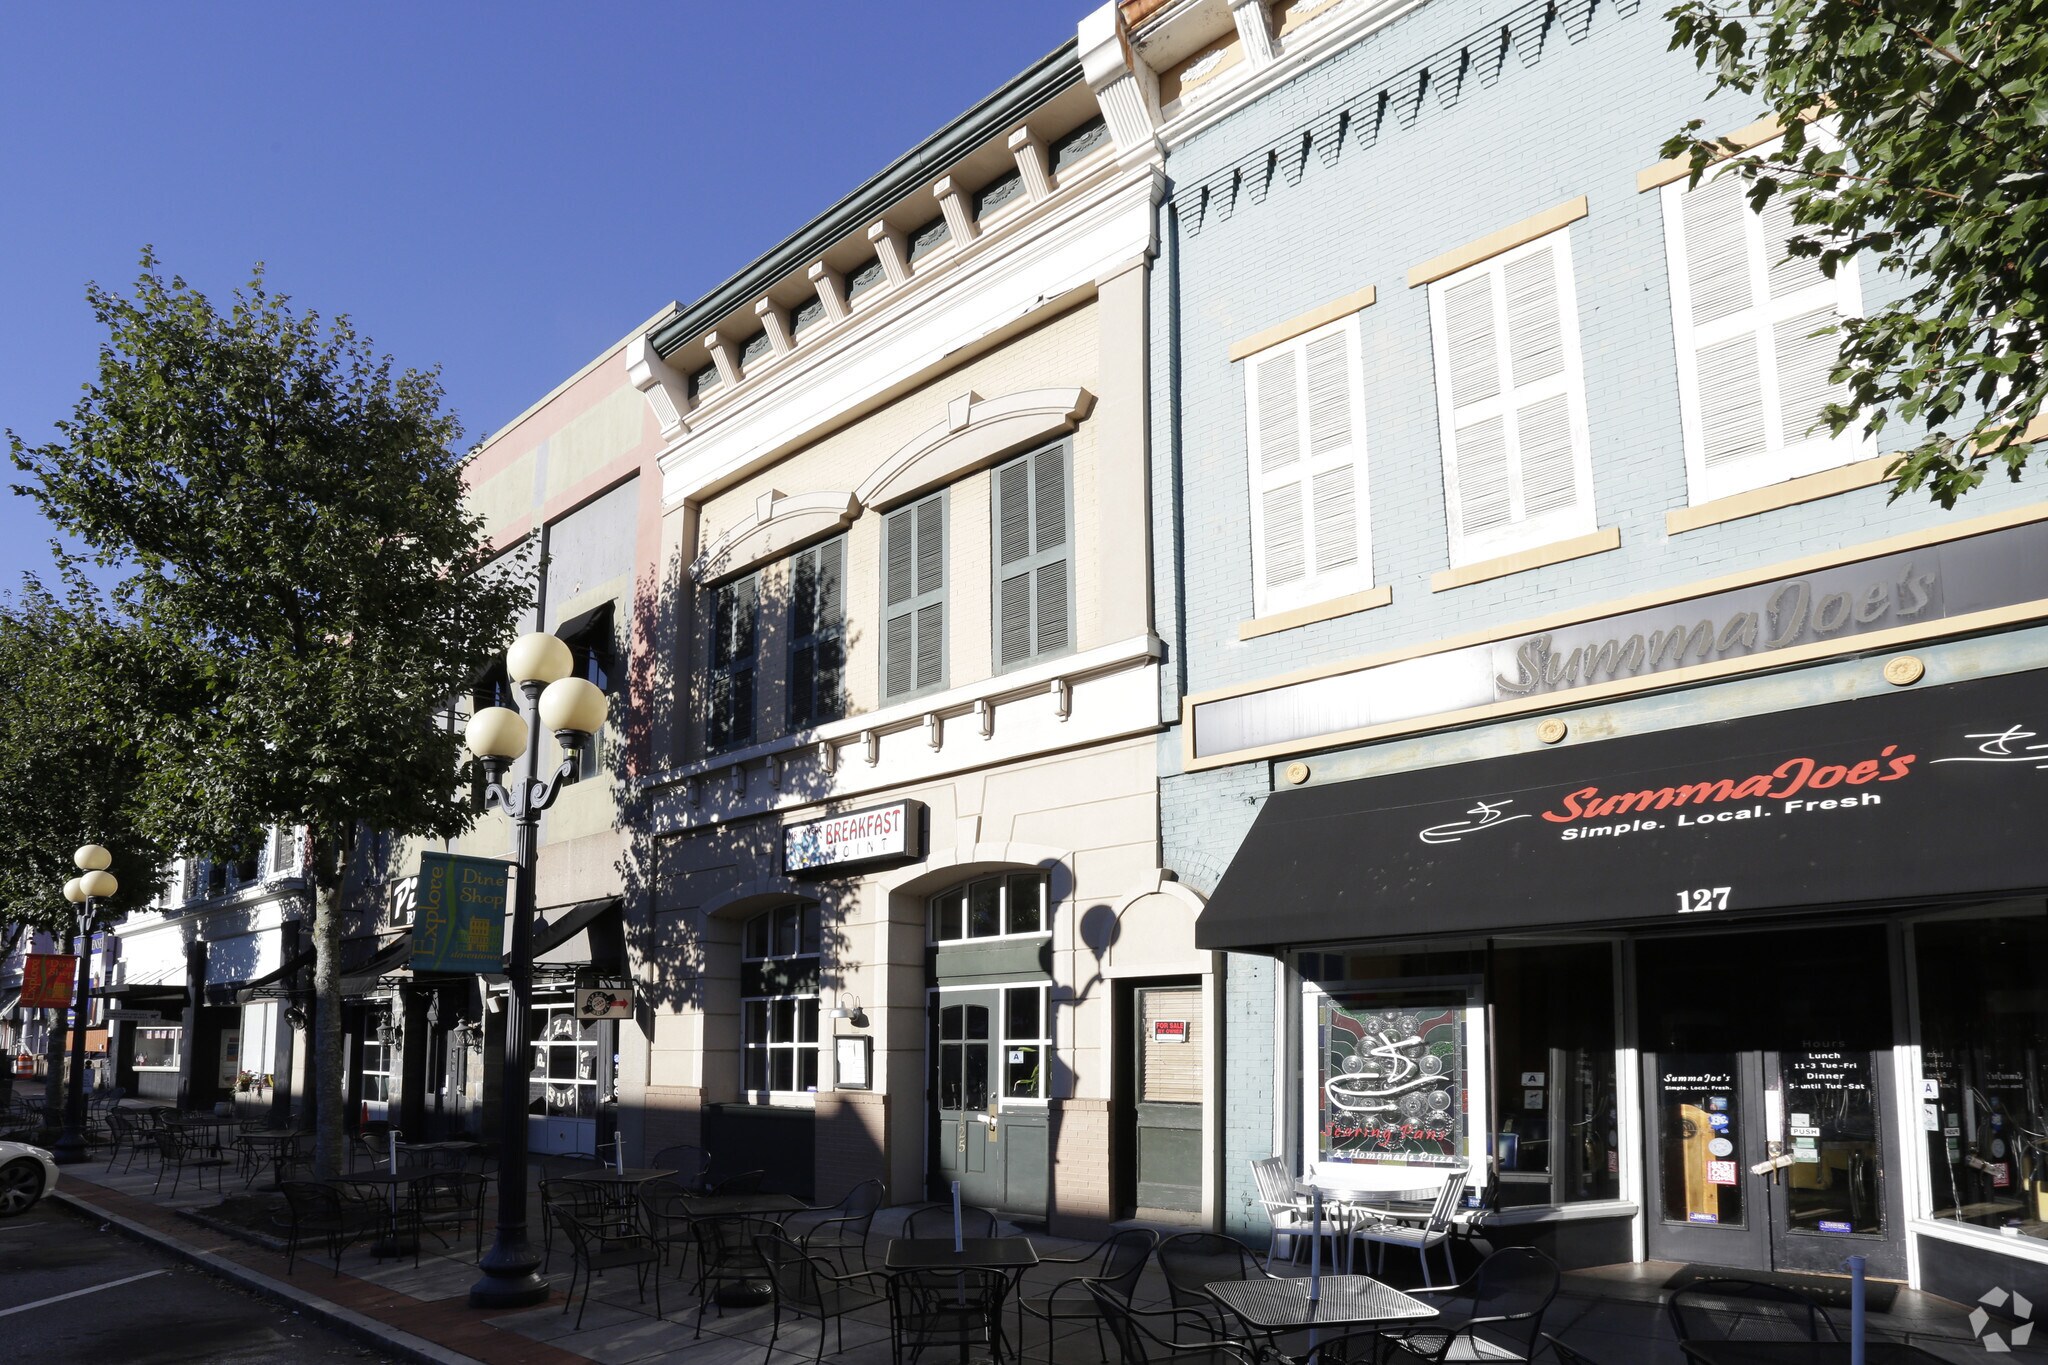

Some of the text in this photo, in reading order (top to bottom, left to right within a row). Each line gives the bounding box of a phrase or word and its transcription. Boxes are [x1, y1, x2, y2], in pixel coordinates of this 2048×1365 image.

[1496, 562, 1935, 693] SummaJoe's
[1542, 745, 1916, 823] SummaJoe's
[826, 809, 900, 845] BREAKFAST
[1561, 792, 1881, 841] Simple. Local. Fresh
[463, 868, 505, 887] Dine
[461, 887, 504, 910] Shop
[1676, 887, 1731, 914] 127
[412, 866, 444, 956] Explore
[1802, 1040, 1845, 1048] Hours
[1808, 1052, 1841, 1060] Lunch
[1663, 1073, 1731, 1084] SummaJoe's
[1806, 1072, 1845, 1080] Dinner
[1925, 1083, 1933, 1092] A
[958, 1112, 966, 1152] 125
[1320, 1121, 1447, 1147] Searing Pans
[1334, 1149, 1453, 1163] & Homemade Pizza
